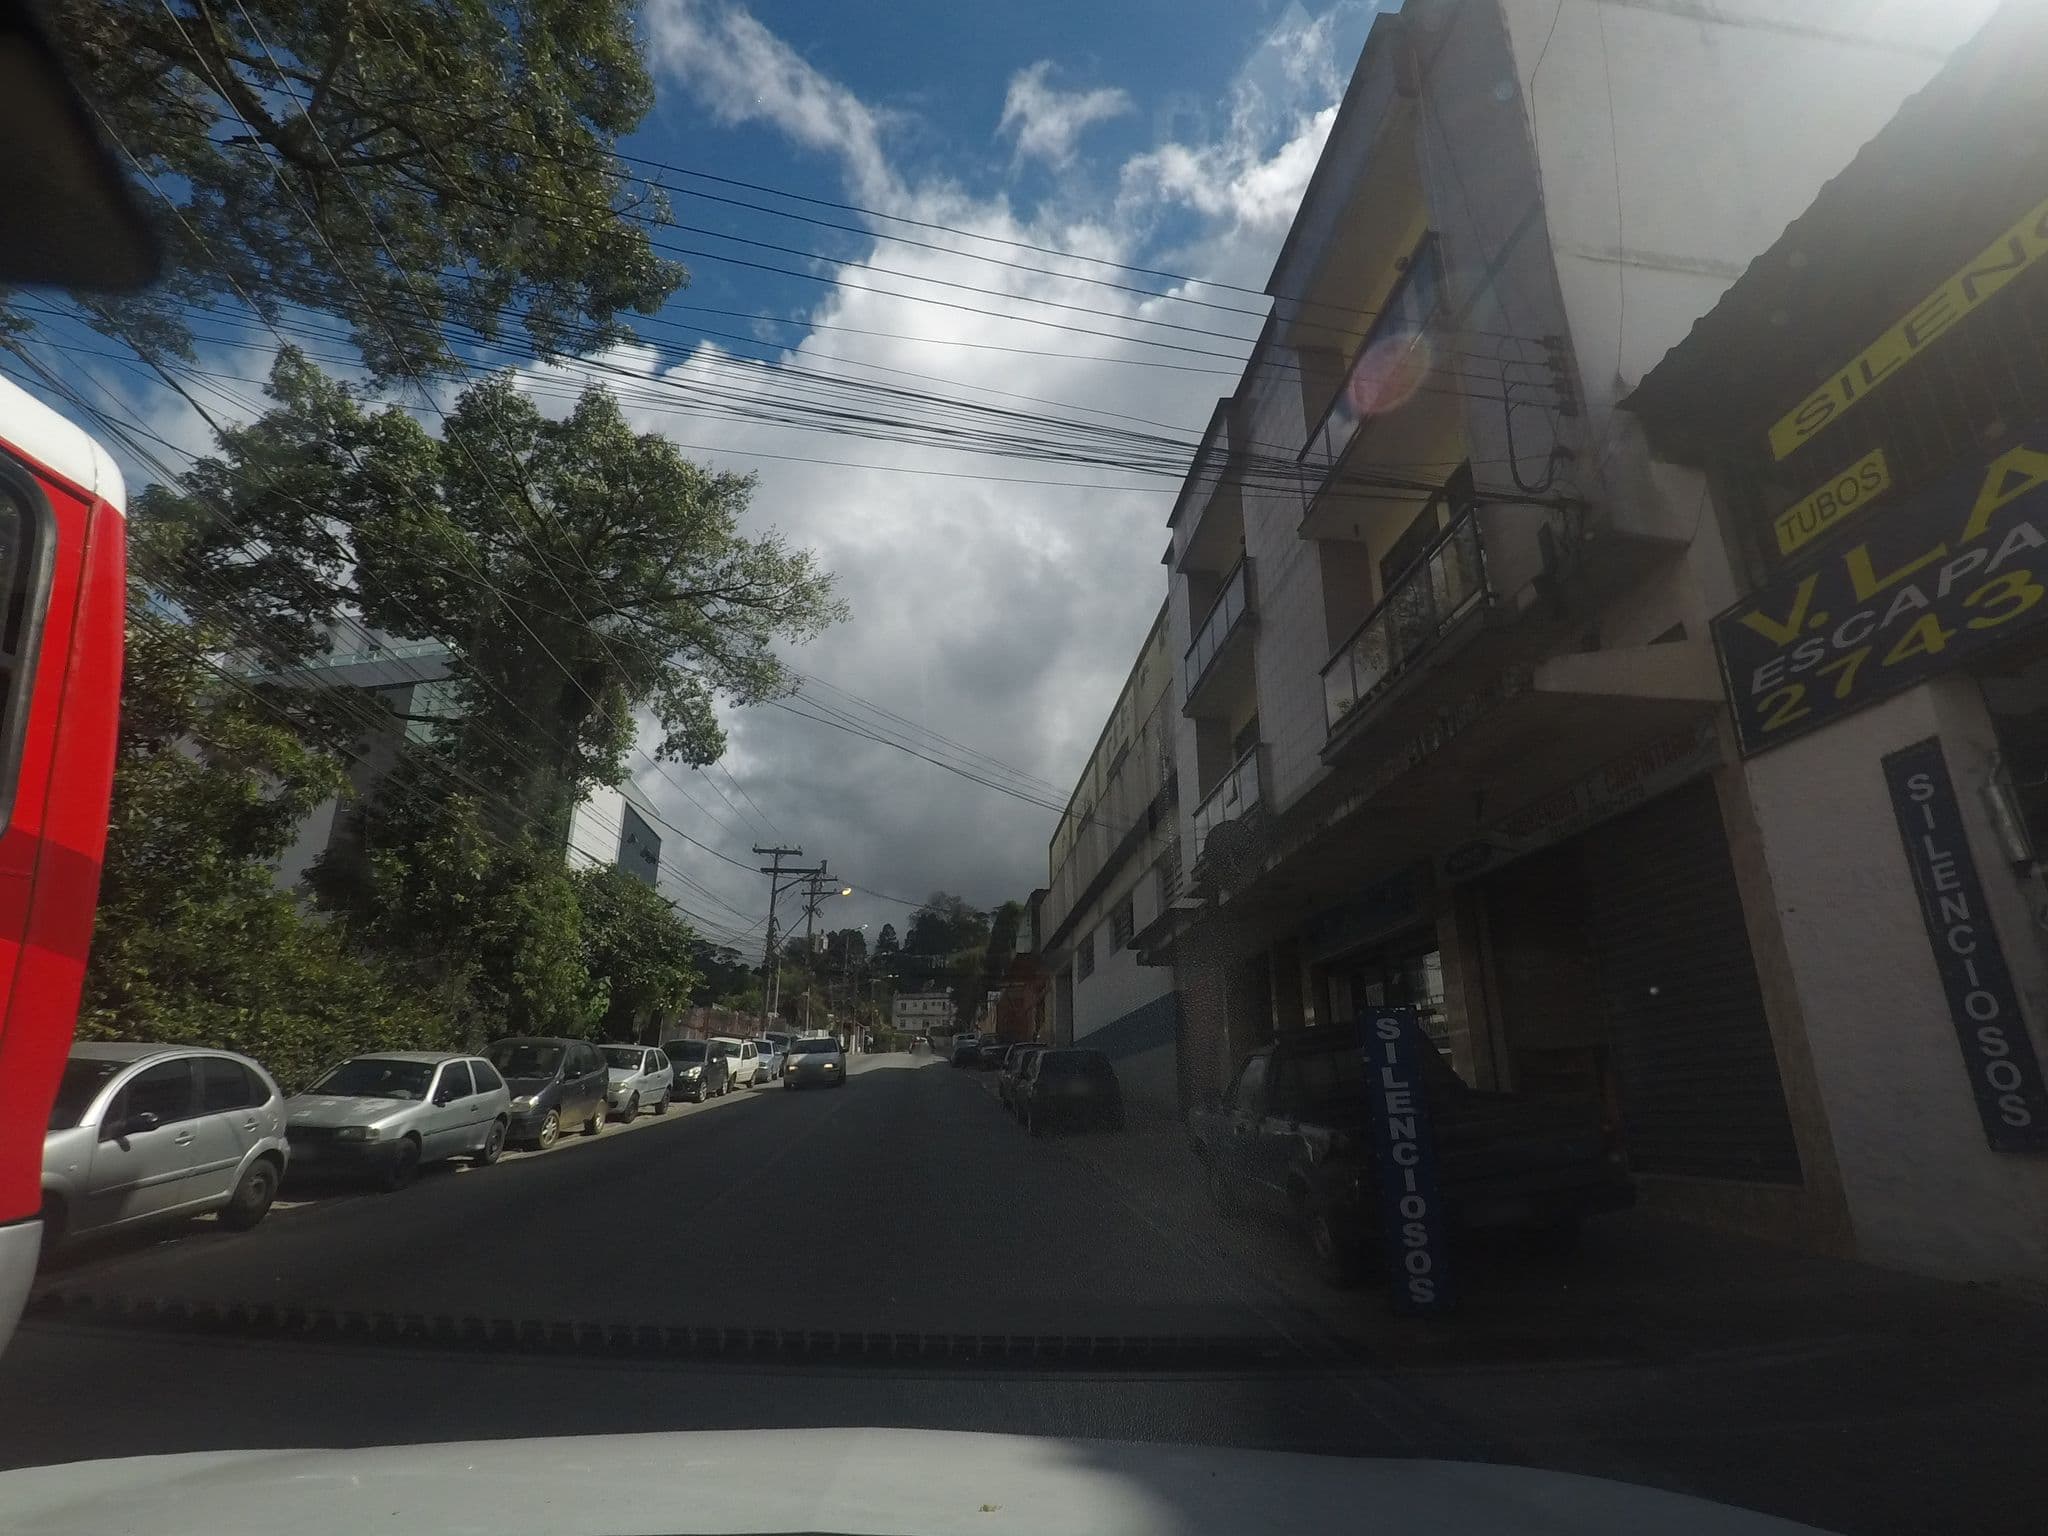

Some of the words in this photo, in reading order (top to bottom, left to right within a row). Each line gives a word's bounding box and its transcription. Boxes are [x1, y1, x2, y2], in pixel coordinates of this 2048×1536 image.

[1781, 462, 1882, 546] TUBOS
[1756, 569, 2044, 733] 2743
[1907, 773, 2031, 1127] SILENCIOSOS
[1376, 1016, 1434, 1303] SILENCIOSOS
